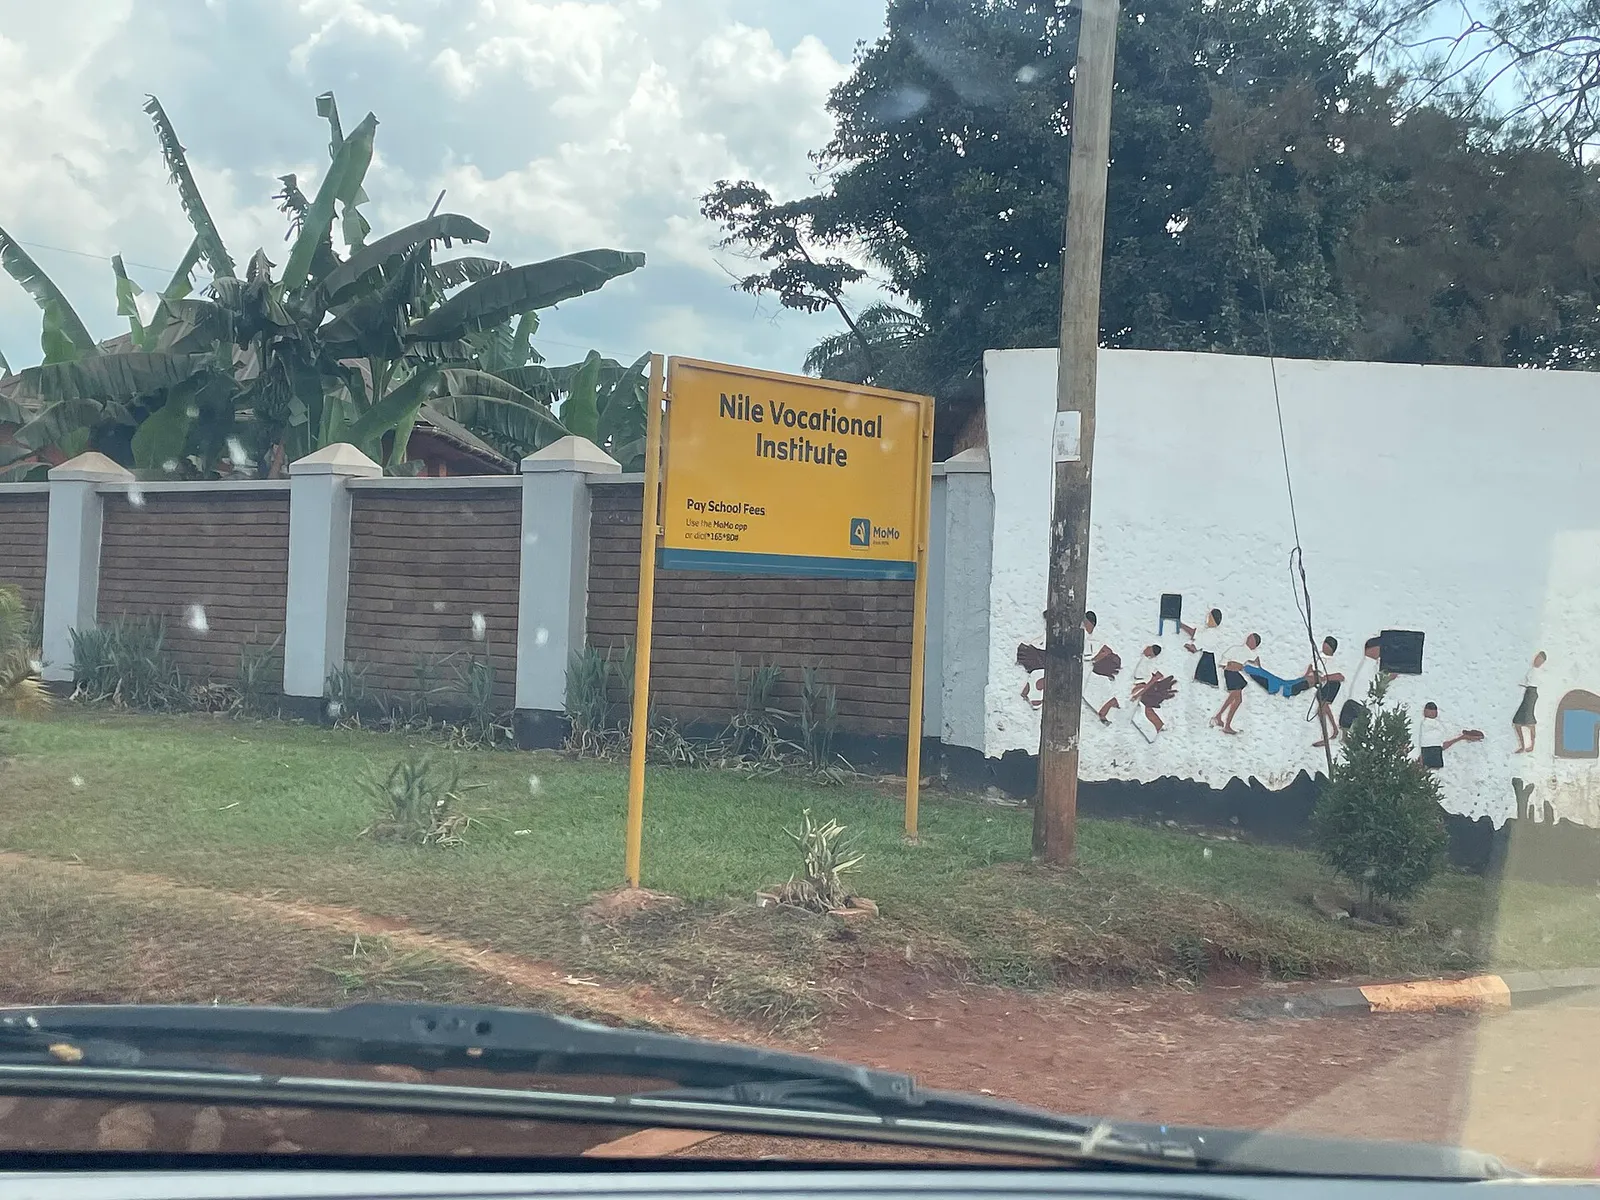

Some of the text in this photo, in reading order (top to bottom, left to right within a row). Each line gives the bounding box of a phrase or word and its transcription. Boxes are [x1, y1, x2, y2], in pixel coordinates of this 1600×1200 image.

[719, 392, 882, 438] Nile Vocational
[756, 432, 848, 467] Institute
[687, 498, 766, 516] Pay School Fees
[686, 518, 748, 532] Use the MoMo app
[873, 526, 900, 540] MoMo
